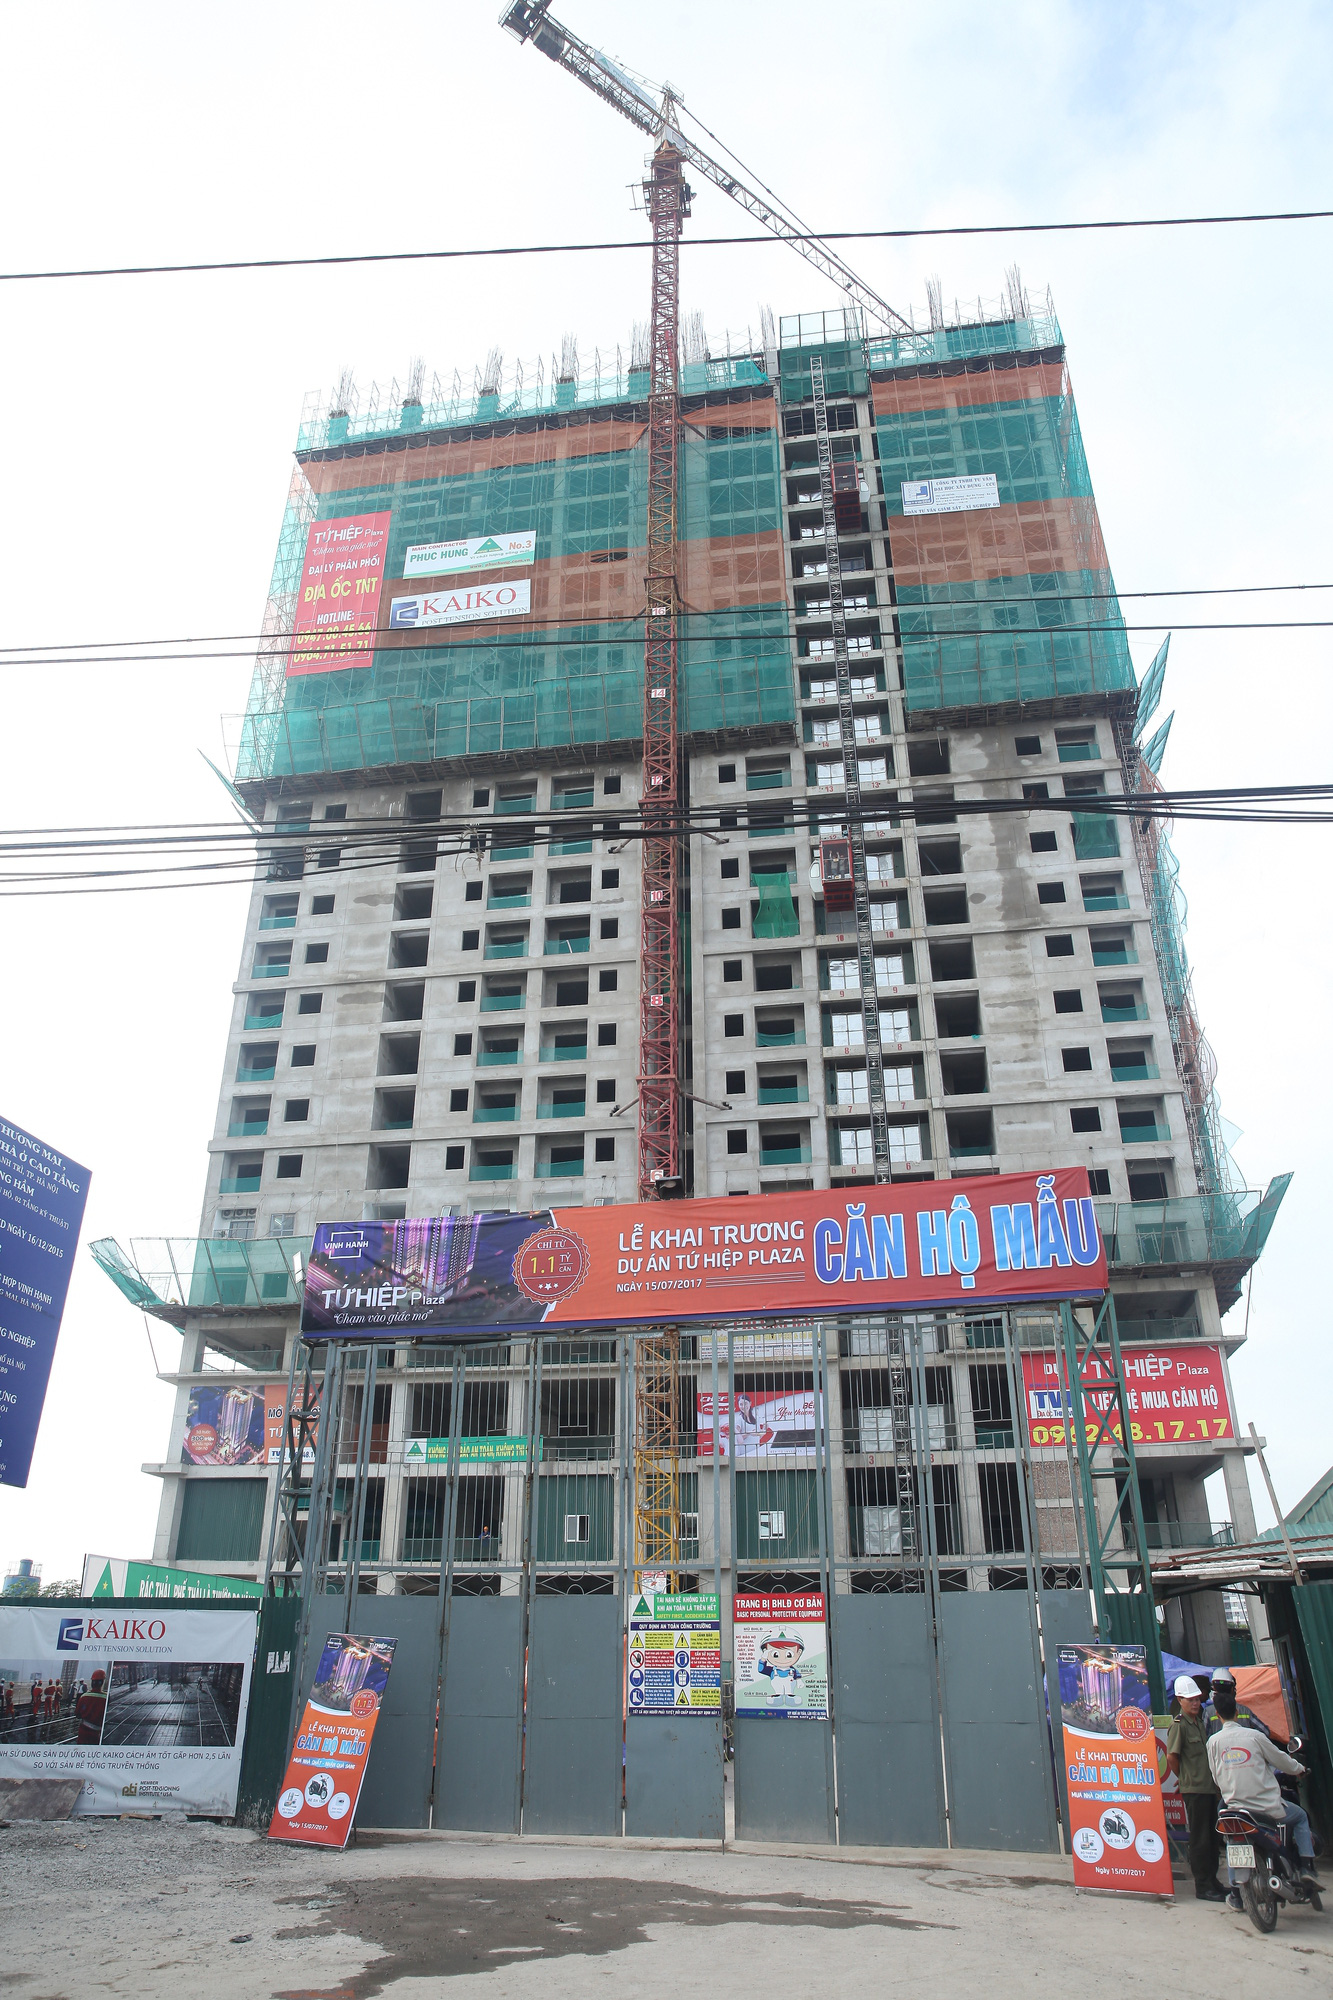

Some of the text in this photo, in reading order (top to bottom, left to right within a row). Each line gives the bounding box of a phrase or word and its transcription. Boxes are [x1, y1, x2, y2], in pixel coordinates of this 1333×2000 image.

[428, 541, 467, 550] CONTRACTOR
[508, 540, 532, 550] No.3
[410, 551, 437, 563] PHUC
[440, 548, 469, 560] HUNG
[308, 554, 380, 577] ĐẠI LÝ PHÂN PHỐI
[304, 575, 378, 605] ĐỊA ỐC TNT
[423, 588, 517, 616] KAIKO
[317, 610, 355, 624] HOTLINE:
[653, 689, 666, 698] 14
[652, 776, 662, 784] 12
[651, 891, 662, 900] 10
[651, 995, 663, 1006] 8
[19, 1149, 80, 1193] Ở CAO TẦNG
[13, 1179, 36, 1197] HẦM
[618, 1220, 805, 1252] LỄ KHAI TRƯƠNG
[814, 1175, 1100, 1289] CĂN HỘ MẪU
[7, 1224, 64, 1258] NGÀY 16/12/2015
[537, 1239, 567, 1249] CHỈ TỪ
[560, 1251, 571, 1262] TỶ
[617, 1247, 805, 1276] DỰ ÁN TỨ HIỆP PLAZA
[530, 1256, 555, 1274] 1.1
[2, 1275, 53, 1305] HỢP VINH HẠNH
[616, 1278, 703, 1293] NGÀY 15/07/2017
[411, 1291, 445, 1306] Plaza
[368, 1313, 386, 1323] vào
[386, 1310, 411, 1325] giấc
[8, 1331, 37, 1349] NGHIỆP
[1177, 1363, 1209, 1375] Plaza
[1141, 1384, 1219, 1410] MUA CĂN HỘ
[428, 1444, 446, 1458] KHÔNG
[471, 1446, 478, 1457] AN
[496, 1442, 514, 1457] KHÔNG
[140, 1575, 154, 1597] RÁC
[736, 1595, 822, 1610] TRANG BỊ BHLĐ CƠ BẢN
[85, 1618, 166, 1640] KAIKO
[83, 1644, 172, 1653] POST TENSION SOLUTION
[309, 1721, 365, 1737] LỄ KHAI TRƯƠNG
[1123, 1720, 1135, 1728] 1.1
[297, 1733, 366, 1756] CĂN HỘ MẪU
[10, 1749, 20, 1758] SỬ
[21, 1751, 41, 1759] DỤNG
[43, 1749, 57, 1758] SÀN
[58, 1750, 70, 1759] DỰ
[71, 1748, 86, 1758] ỨNG
[87, 1751, 101, 1759] LỰC
[125, 1750, 145, 1759] CÁCH
[146, 1750, 156, 1759] ÂM
[159, 1749, 171, 1759] TỐT
[173, 1750, 187, 1760] GẤP
[205, 1752, 216, 1761] 2,5
[218, 1751, 231, 1760] LẦN
[1075, 1748, 1148, 1763] LỄ KHAI TRƯƠNG
[33, 1760, 160, 1770] SO VỚI SÀN BÊ TÔNG TRUYỀN THỐNG
[1069, 1761, 1155, 1787] CĂN HỘ MẪU
[122, 1783, 138, 1796] pti
[301, 1823, 328, 1831] 15/07/2017
[1095, 1867, 1146, 1876] Ngày 15/07/2017
